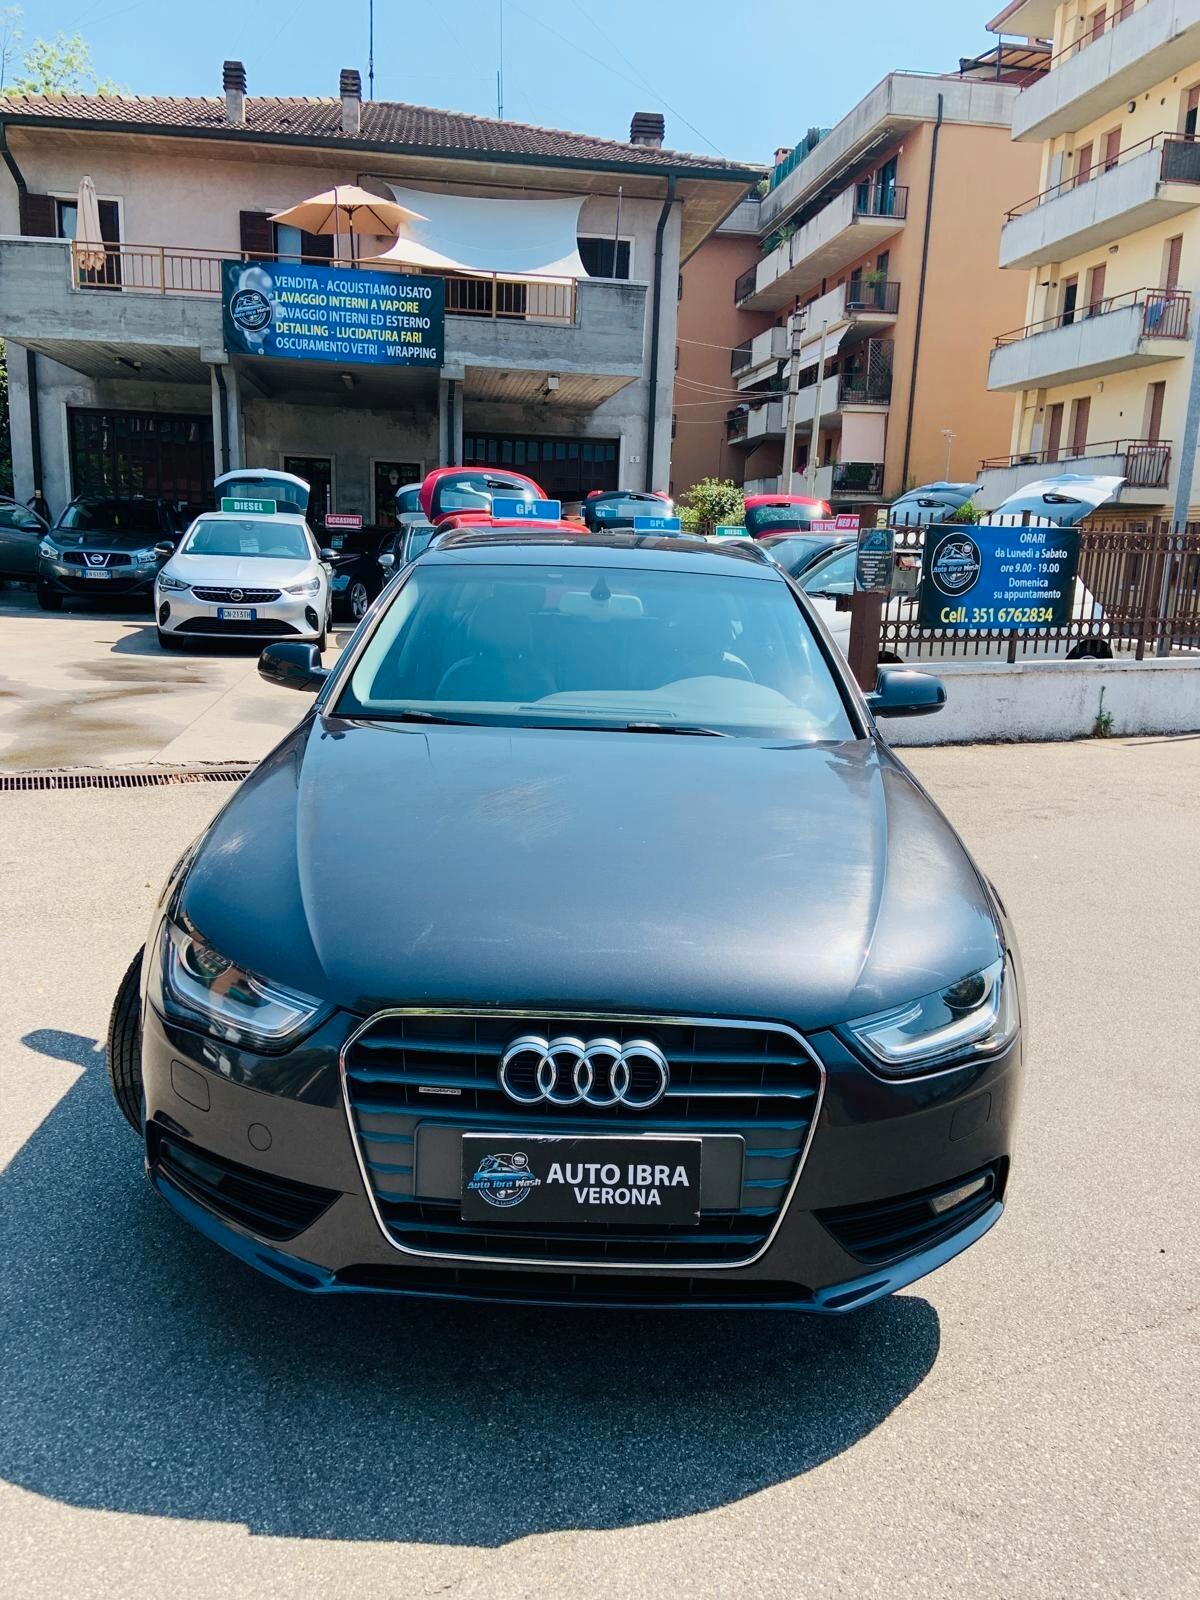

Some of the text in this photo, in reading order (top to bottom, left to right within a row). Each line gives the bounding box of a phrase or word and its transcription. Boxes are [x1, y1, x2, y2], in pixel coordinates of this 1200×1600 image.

[274, 275, 319, 290] VENDITA
[326, 279, 397, 297] ACQUISTIAMO
[399, 285, 432, 299] USATO
[275, 291, 419, 313] LAVAGGIO INTERNI A VAPORE
[275, 306, 327, 321] LAVAGGIO
[329, 310, 368, 325] INTERNI
[370, 313, 384, 326] ED
[386, 315, 431, 329] ESTERNO
[275, 322, 329, 336] DETAILING
[336, 326, 399, 342] LUCIDATURA
[400, 331, 422, 343] FARI
[275, 337, 350, 353] OSCURAMENTO
[351, 342, 378, 355] VETRI
[386, 345, 437, 359] WRAPPING
[233, 501, 264, 511] DIESEL
[515, 503, 539, 516] GPL
[327, 516, 360, 525] OCCASIONE
[649, 519, 665, 528] GPL
[837, 518, 851, 527] NEO
[724, 528, 743, 536] DIESEL
[1019, 533, 1047, 544] ORARI
[994, 547, 1005, 558] da
[1034, 550, 1040, 558] a
[1041, 547, 1068, 559] Sabato
[1000, 564, 1014, 573] ore
[1015, 563, 1032, 573] 9.00
[1038, 563, 1060, 573] 19.00
[1008, 577, 1049, 588] Domenica
[993, 589, 1061, 601] su appuntamento
[940, 606, 1053, 623] Cell. 351 6762834
[546, 1163, 690, 1187] AUTO IBRA
[466, 1181, 491, 1190] Auto
[515, 1178, 542, 1187] Wash
[573, 1187, 662, 1206] VERONA
